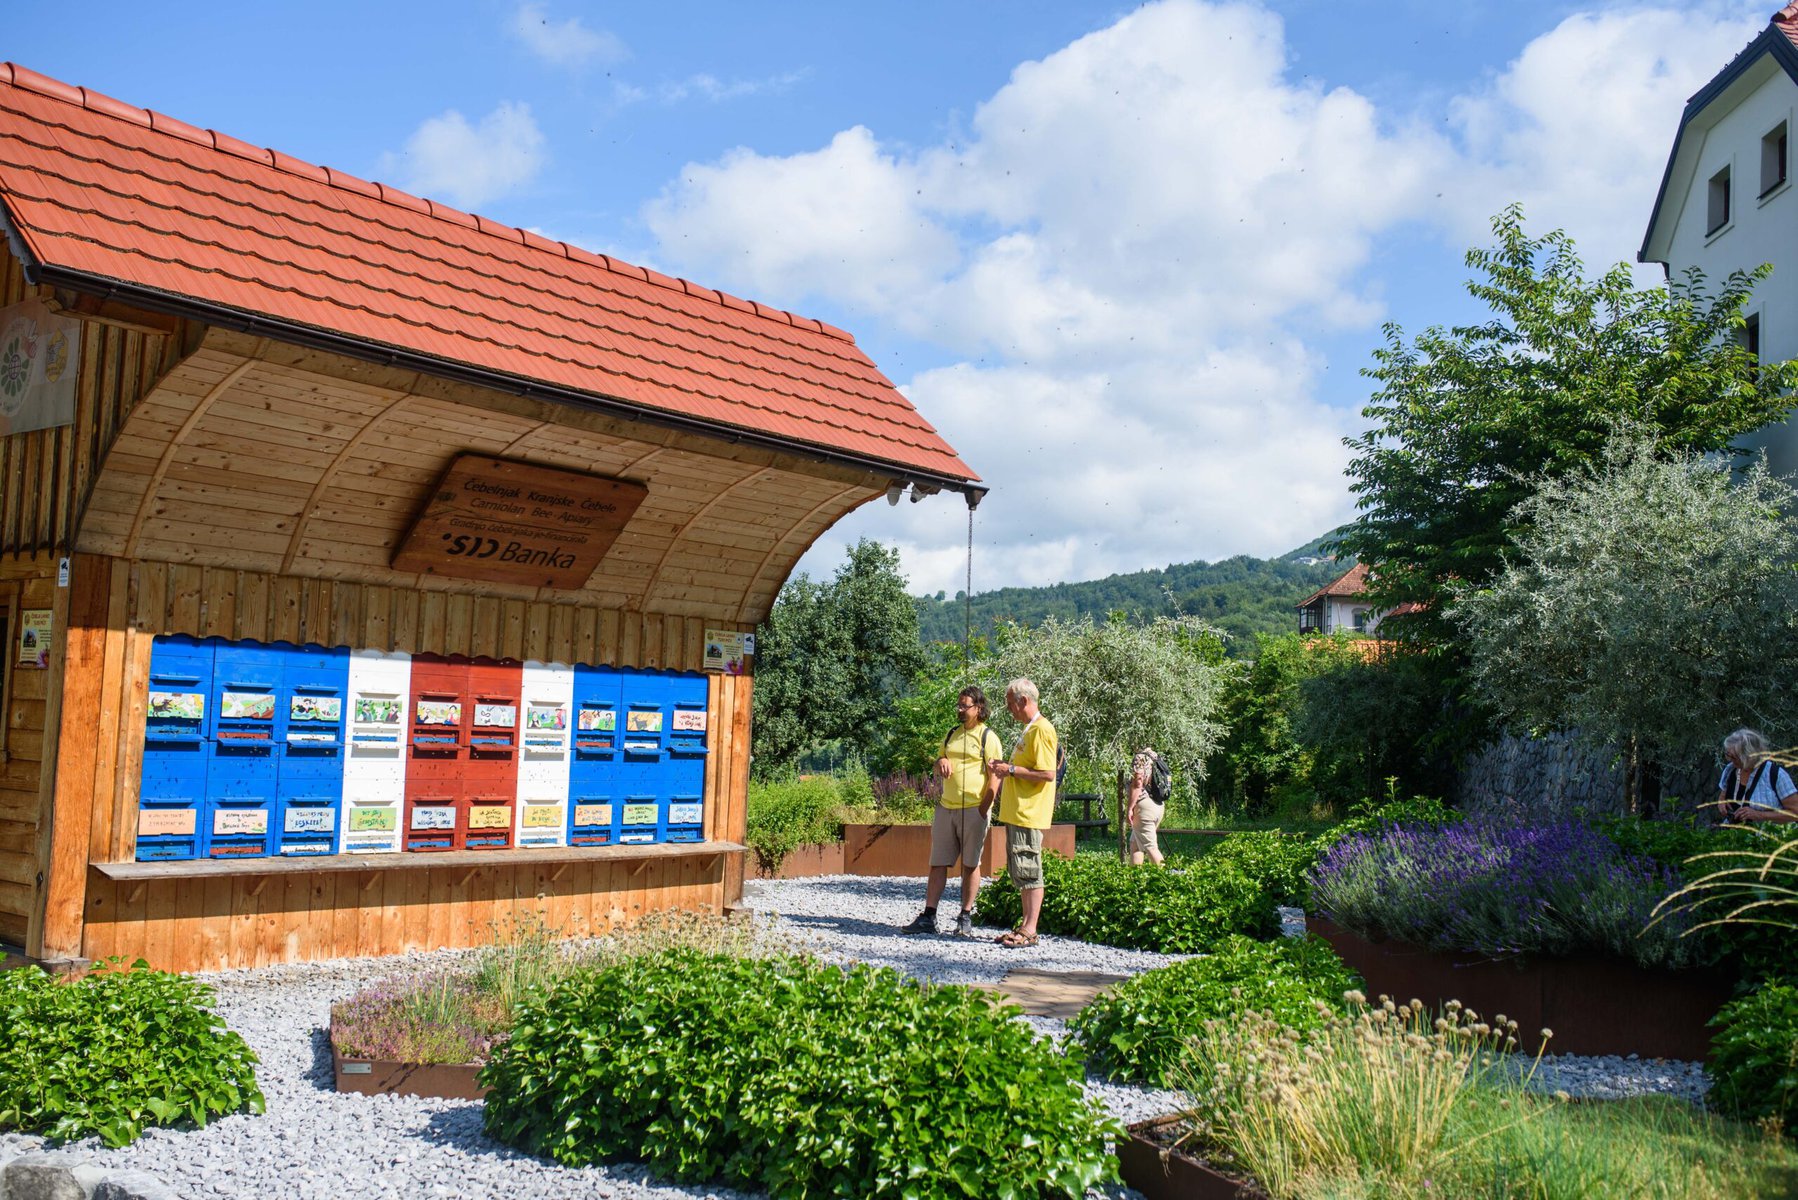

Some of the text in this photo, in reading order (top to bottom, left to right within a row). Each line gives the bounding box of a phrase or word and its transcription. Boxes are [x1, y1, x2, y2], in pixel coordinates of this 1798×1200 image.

[464, 478, 617, 514] Čebelnjak Kranjske Čebele
[470, 497, 526, 515] Carniolan
[499, 541, 577, 569] Banka
